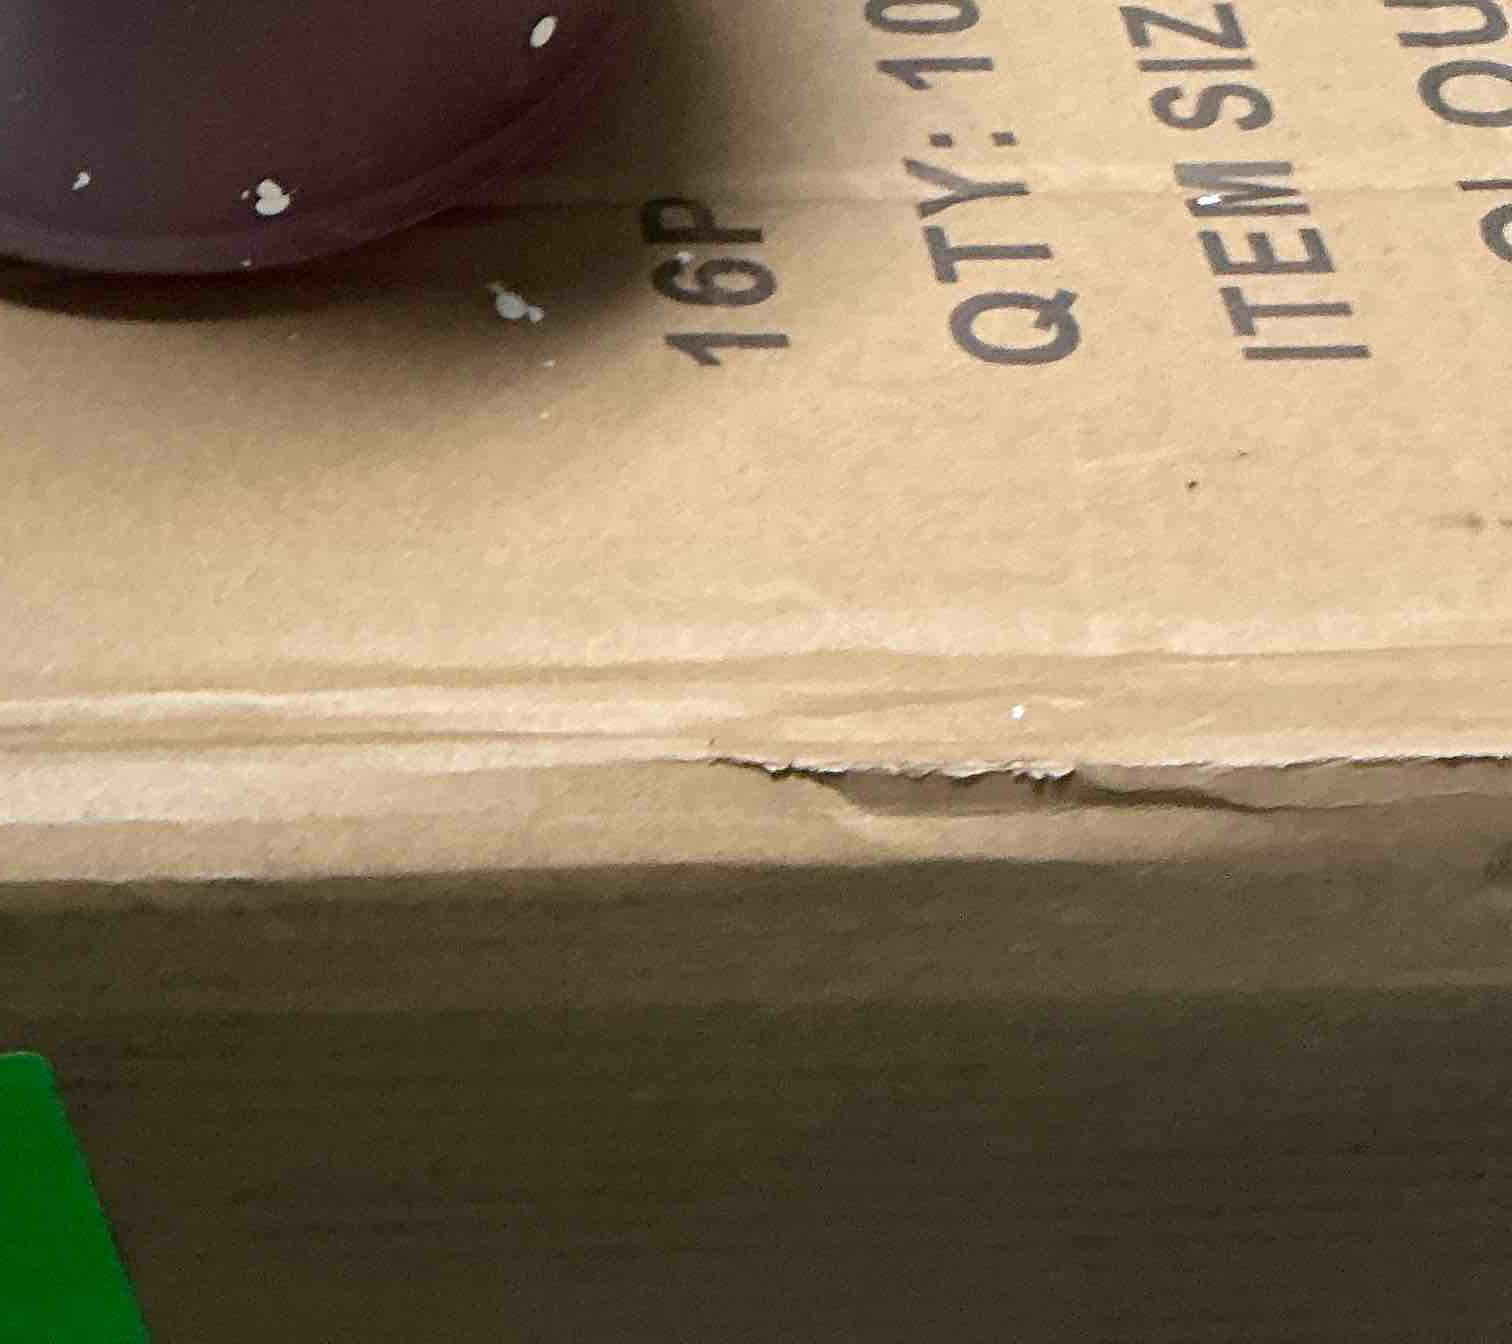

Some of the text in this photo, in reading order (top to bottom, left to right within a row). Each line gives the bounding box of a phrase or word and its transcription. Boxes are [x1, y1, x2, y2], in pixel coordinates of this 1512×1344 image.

[640, 195, 791, 367] 16P
[904, 129, 1082, 367] QTY:
[1173, 161, 1371, 361] ITEM
